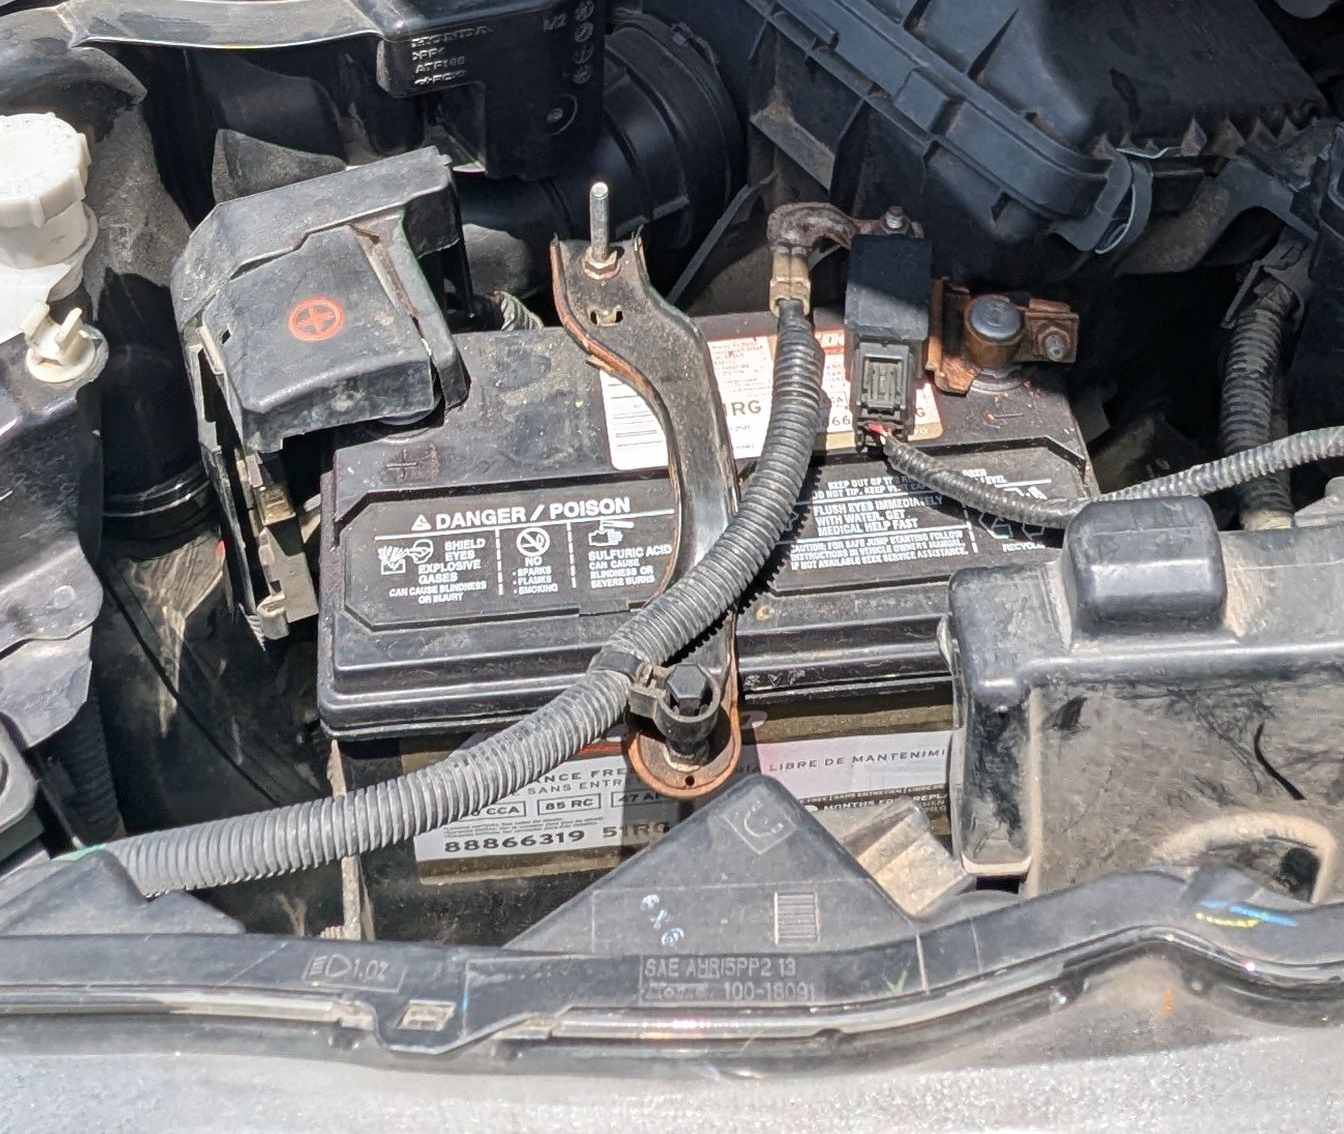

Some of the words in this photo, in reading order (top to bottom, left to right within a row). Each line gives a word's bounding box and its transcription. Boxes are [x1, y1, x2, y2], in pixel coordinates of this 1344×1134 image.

[828, 479, 849, 490] KEEP
[852, 478, 868, 487] OUT
[870, 477, 883, 486] OF
[826, 488, 844, 497] NOT
[864, 486, 885, 494] KEEP
[814, 504, 846, 516] FLUSH
[849, 502, 874, 513] EYES
[876, 496, 943, 510] IMMEDIATELY
[435, 506, 526, 531] DANGER
[549, 496, 631, 520] POISON
[815, 515, 842, 526] WITH
[886, 509, 906, 520] GET
[817, 524, 863, 537] MEDICAL
[865, 520, 890, 532] HELP
[893, 518, 918, 529] FAST
[445, 538, 485, 550] SHIELD
[827, 541, 844, 550] FOR
[845, 539, 865, 548] SAFE
[929, 531, 963, 540] FOLLOW
[445, 550, 475, 561] EYES
[588, 547, 644, 561] SULFURIC
[645, 544, 672, 557] ACID
[418, 559, 481, 574] EXPLOSIVE
[525, 556, 542, 567] NO
[589, 561, 608, 570] CAN
[611, 558, 640, 568] CAUSE
[517, 566, 551, 576] SPARKS
[590, 567, 637, 579] BLINDNESS
[639, 565, 653, 575] OR
[418, 572, 458, 584] GASES
[518, 575, 552, 586] FLAMES
[591, 578, 624, 589] SEVERE
[625, 574, 655, 587] BURNS
[389, 588, 408, 597] CAN
[409, 585, 438, 596] CAUSE
[440, 580, 487, 593] BLINDNESS
[519, 583, 558, 595] SMOKING
[418, 595, 432, 604] OR
[433, 592, 464, 603] INJURY
[769, 759, 818, 771] LIBRE
[824, 757, 845, 766] DE
[528, 783, 572, 795] SANS
[486, 805, 520, 815] CCA
[571, 798, 594, 809] RC
[444, 831, 585, 853] 88866319
[644, 958, 680, 977] SAE
